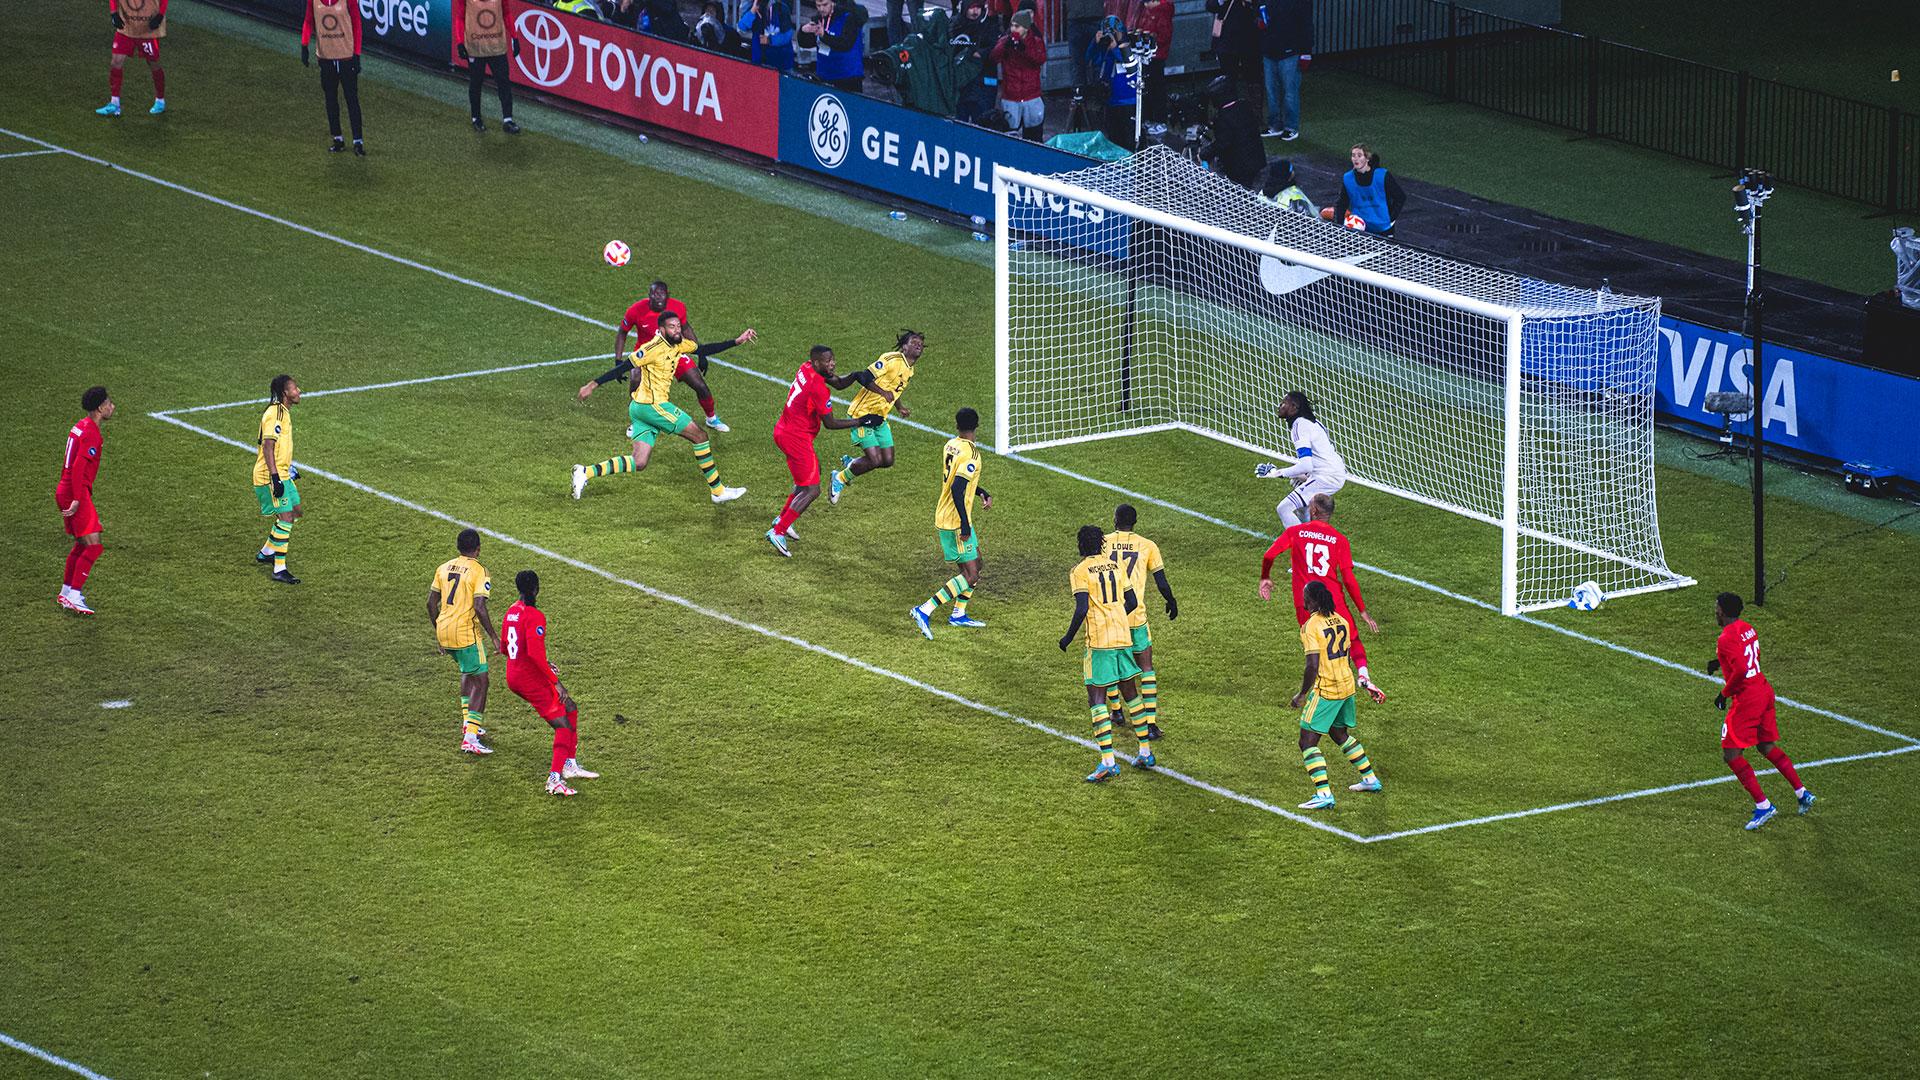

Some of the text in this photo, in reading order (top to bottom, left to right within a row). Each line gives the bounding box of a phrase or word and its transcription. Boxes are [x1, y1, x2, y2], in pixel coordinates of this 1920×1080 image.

[359, 0, 429, 36] egree
[142, 42, 154, 56] 21
[579, 35, 723, 122] TOYOTA
[861, 126, 1105, 223] GE APPLANCES
[1658, 326, 1799, 437] VISA
[1112, 543, 1134, 551] LOWE
[1299, 530, 1337, 545] CORNELIUS
[1304, 542, 1331, 577] 13
[446, 572, 461, 606] 7
[1098, 570, 1118, 605] 11
[506, 626, 518, 660] 8
[1323, 624, 1348, 661] 22
